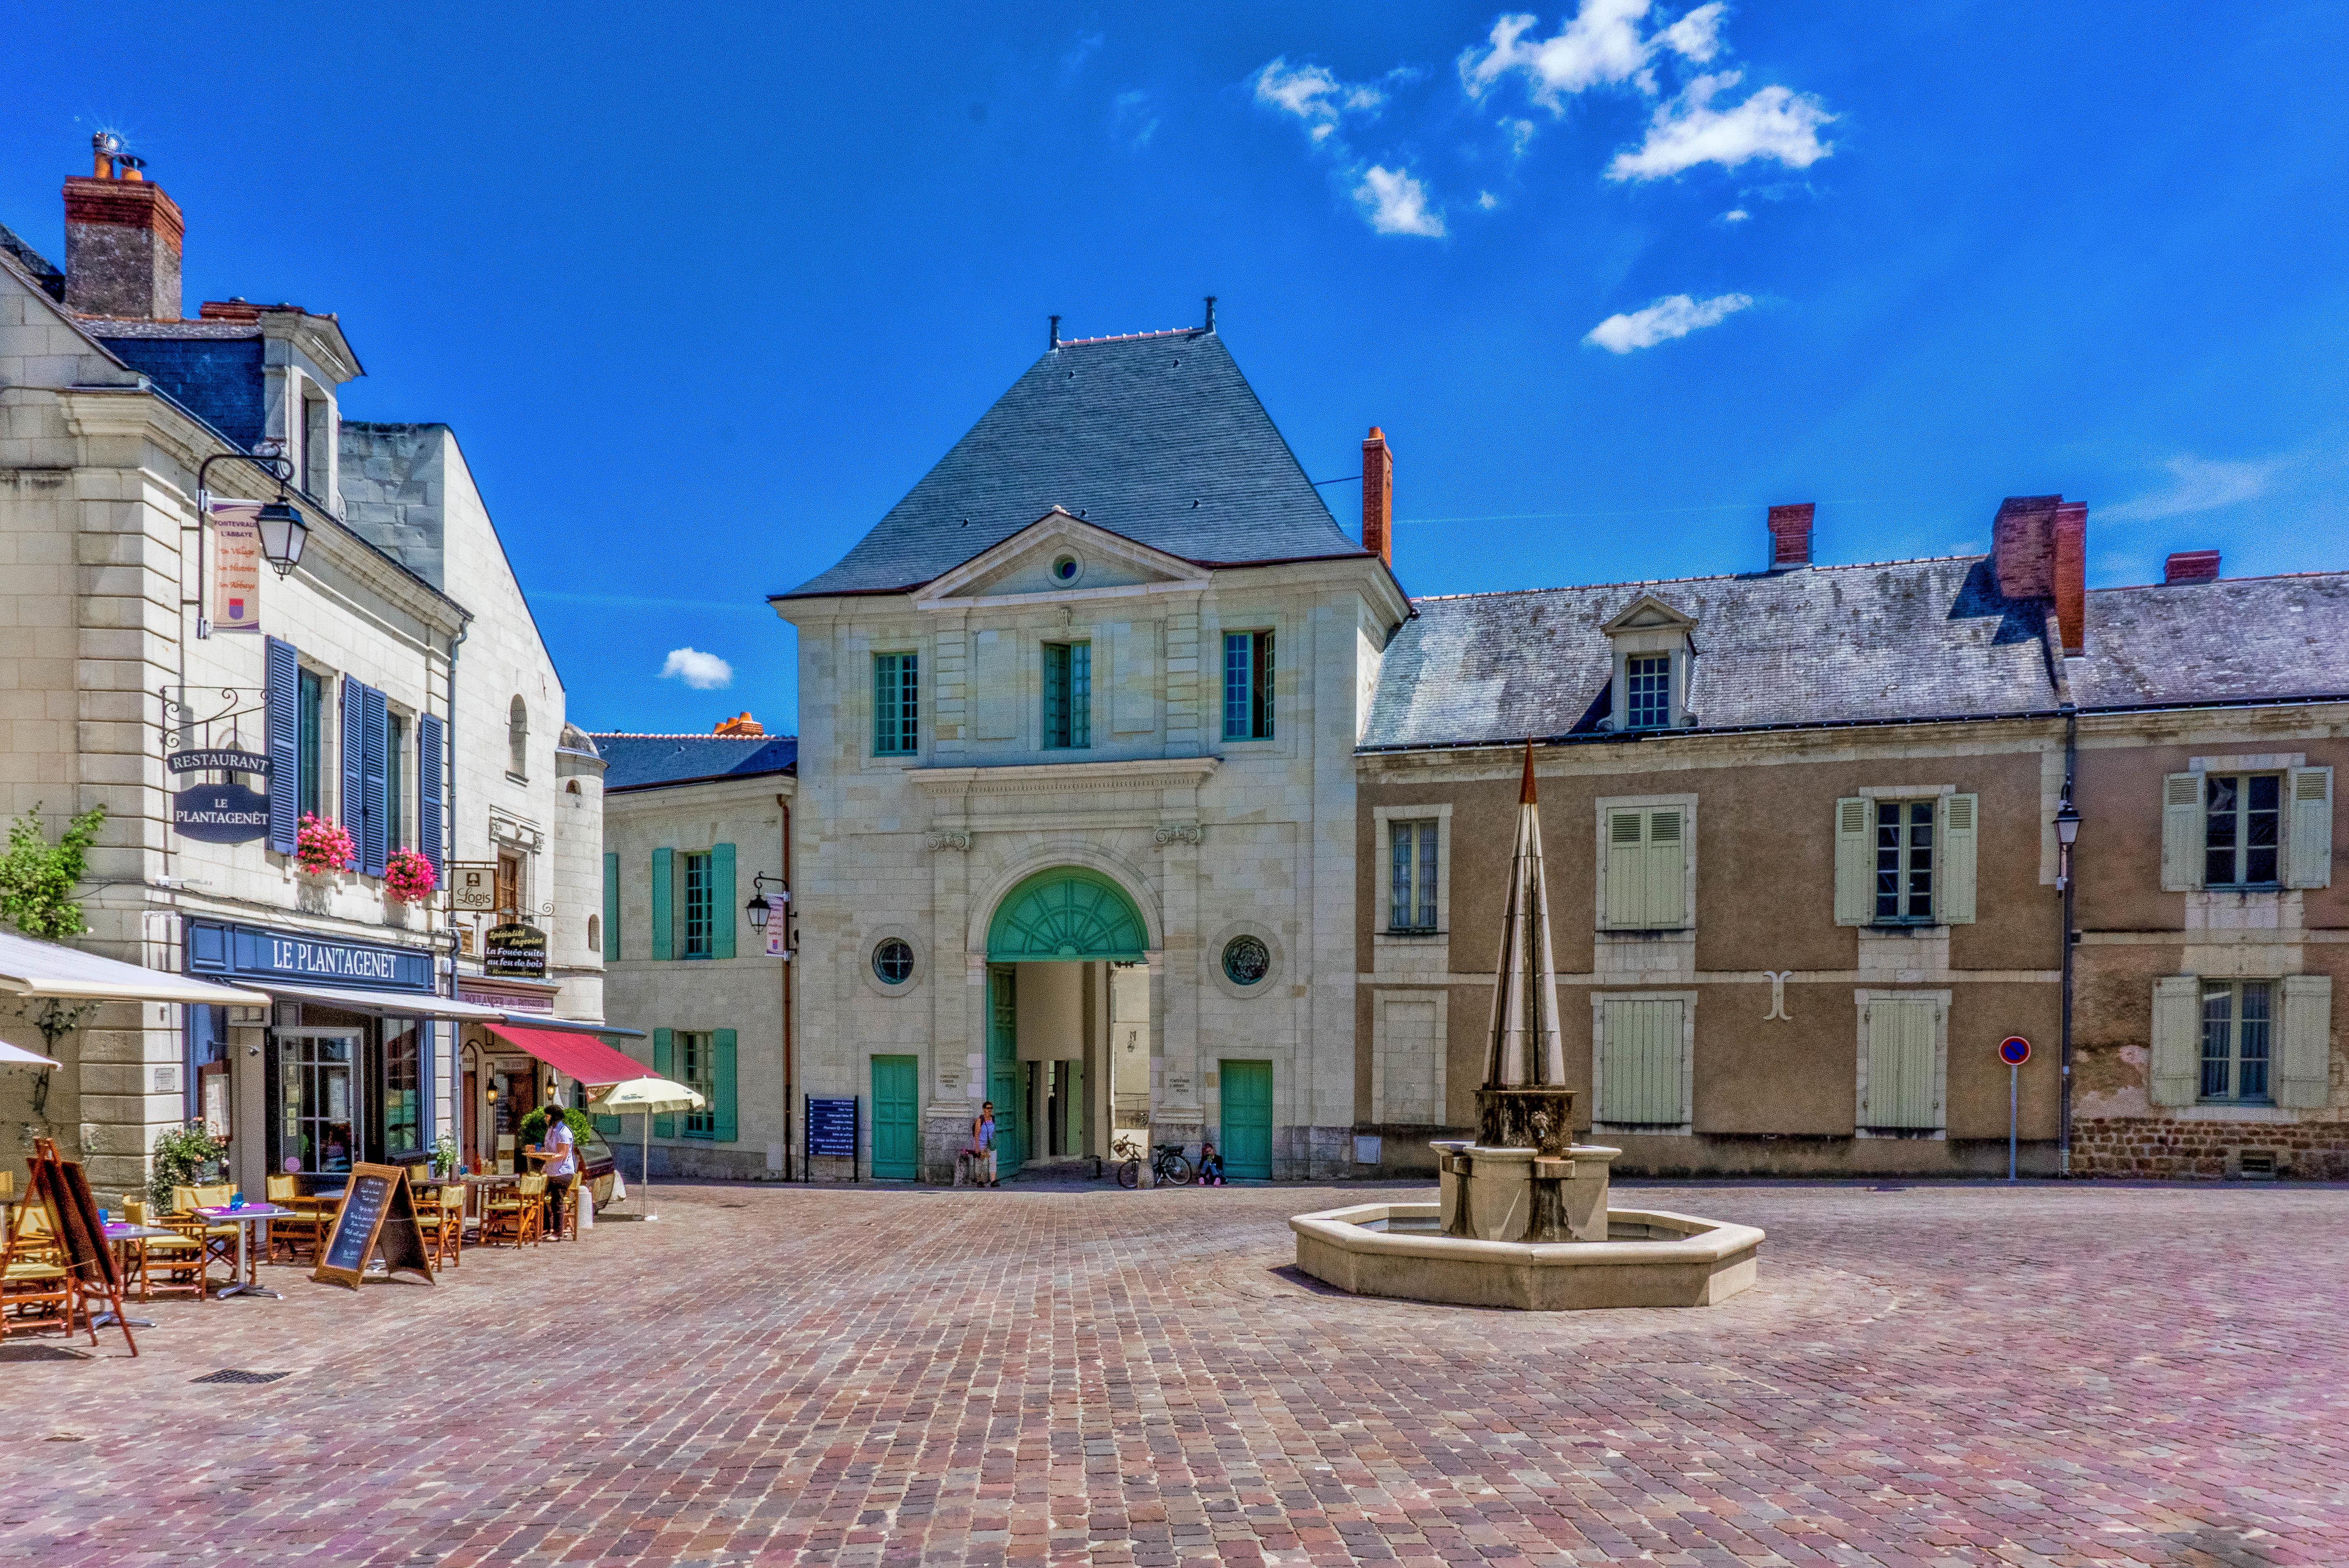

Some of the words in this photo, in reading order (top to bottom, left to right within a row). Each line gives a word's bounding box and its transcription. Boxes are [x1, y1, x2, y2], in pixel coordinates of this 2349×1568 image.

[172, 754, 270, 772] RESTAURANT
[215, 798, 228, 808] LE
[176, 811, 269, 825] PLANTAGENÊT
[456, 887, 491, 907] Logis
[489, 929, 526, 941] Spécialité
[509, 936, 543, 948] Angevine
[486, 947, 497, 955] La
[497, 948, 522, 956] Fouée
[523, 949, 545, 957] cuite
[272, 940, 293, 969] LE
[297, 943, 397, 978] PLANTAGENÊT
[499, 957, 513, 966] feu
[514, 959, 525, 967] de
[526, 959, 543, 968] bois
